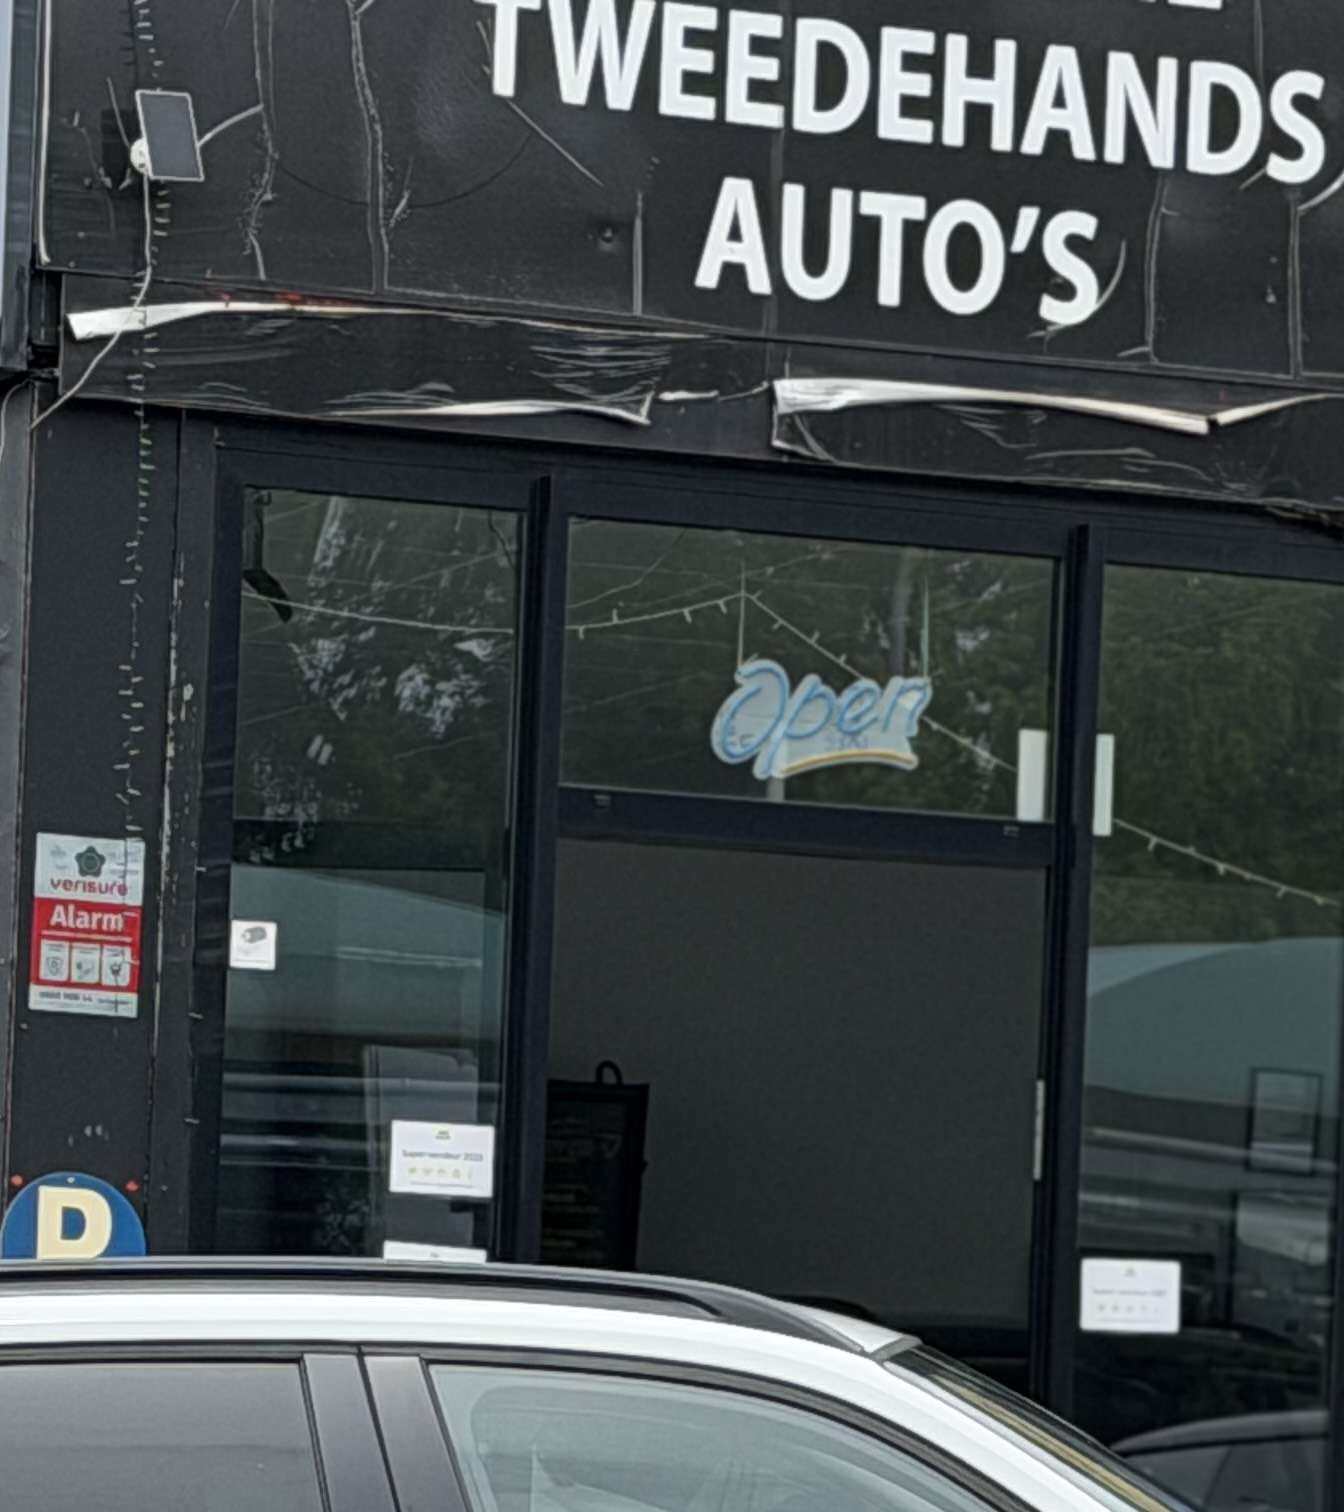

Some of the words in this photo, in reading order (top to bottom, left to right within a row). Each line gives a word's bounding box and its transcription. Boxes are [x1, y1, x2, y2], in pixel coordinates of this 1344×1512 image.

[480, 0, 1327, 184] TWEEDEHANDS
[712, 660, 932, 780] Open
[49, 877, 129, 897] verisure
[49, 903, 125, 932] Alarm
